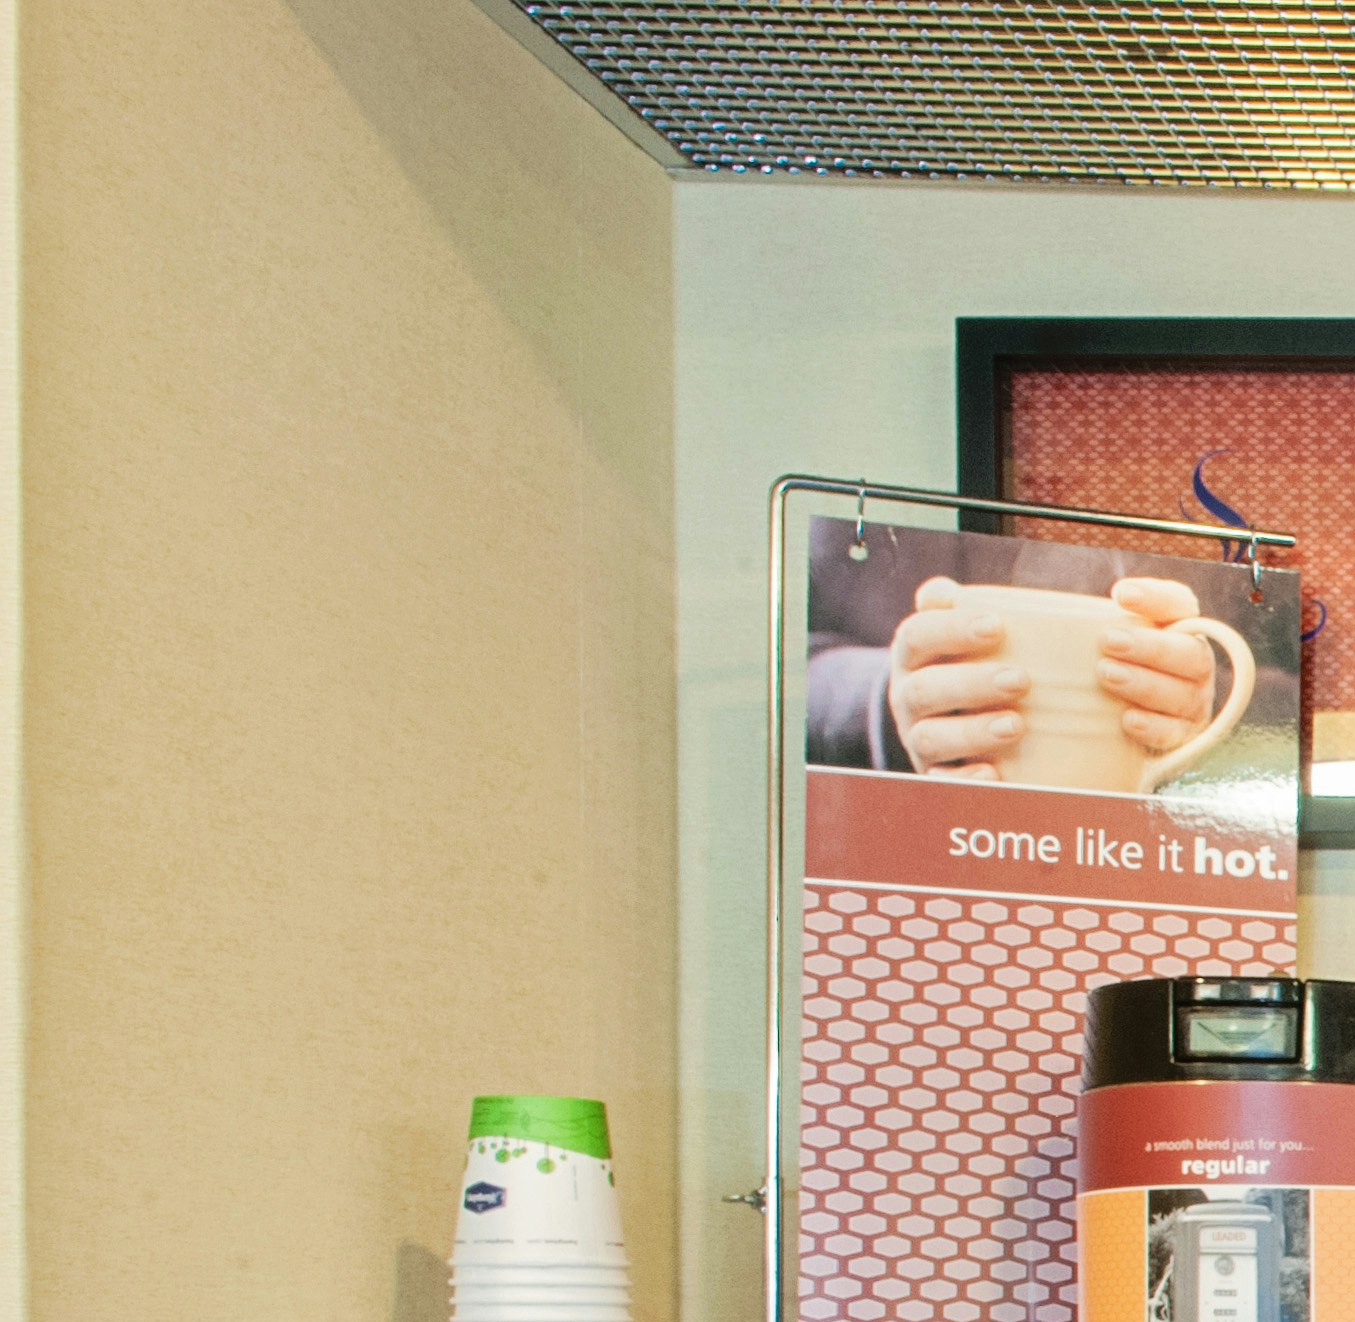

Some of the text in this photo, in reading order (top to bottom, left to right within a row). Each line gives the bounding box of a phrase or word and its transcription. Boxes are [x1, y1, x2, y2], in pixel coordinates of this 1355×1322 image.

[948, 826, 1289, 881] some like it hot.
[1144, 1142, 1152, 1152] a
[1153, 1139, 1194, 1152] smooth
[1196, 1138, 1231, 1151] blend
[1232, 1138, 1255, 1154] just
[1258, 1137, 1277, 1150] for
[1181, 1155, 1271, 1179] regular
